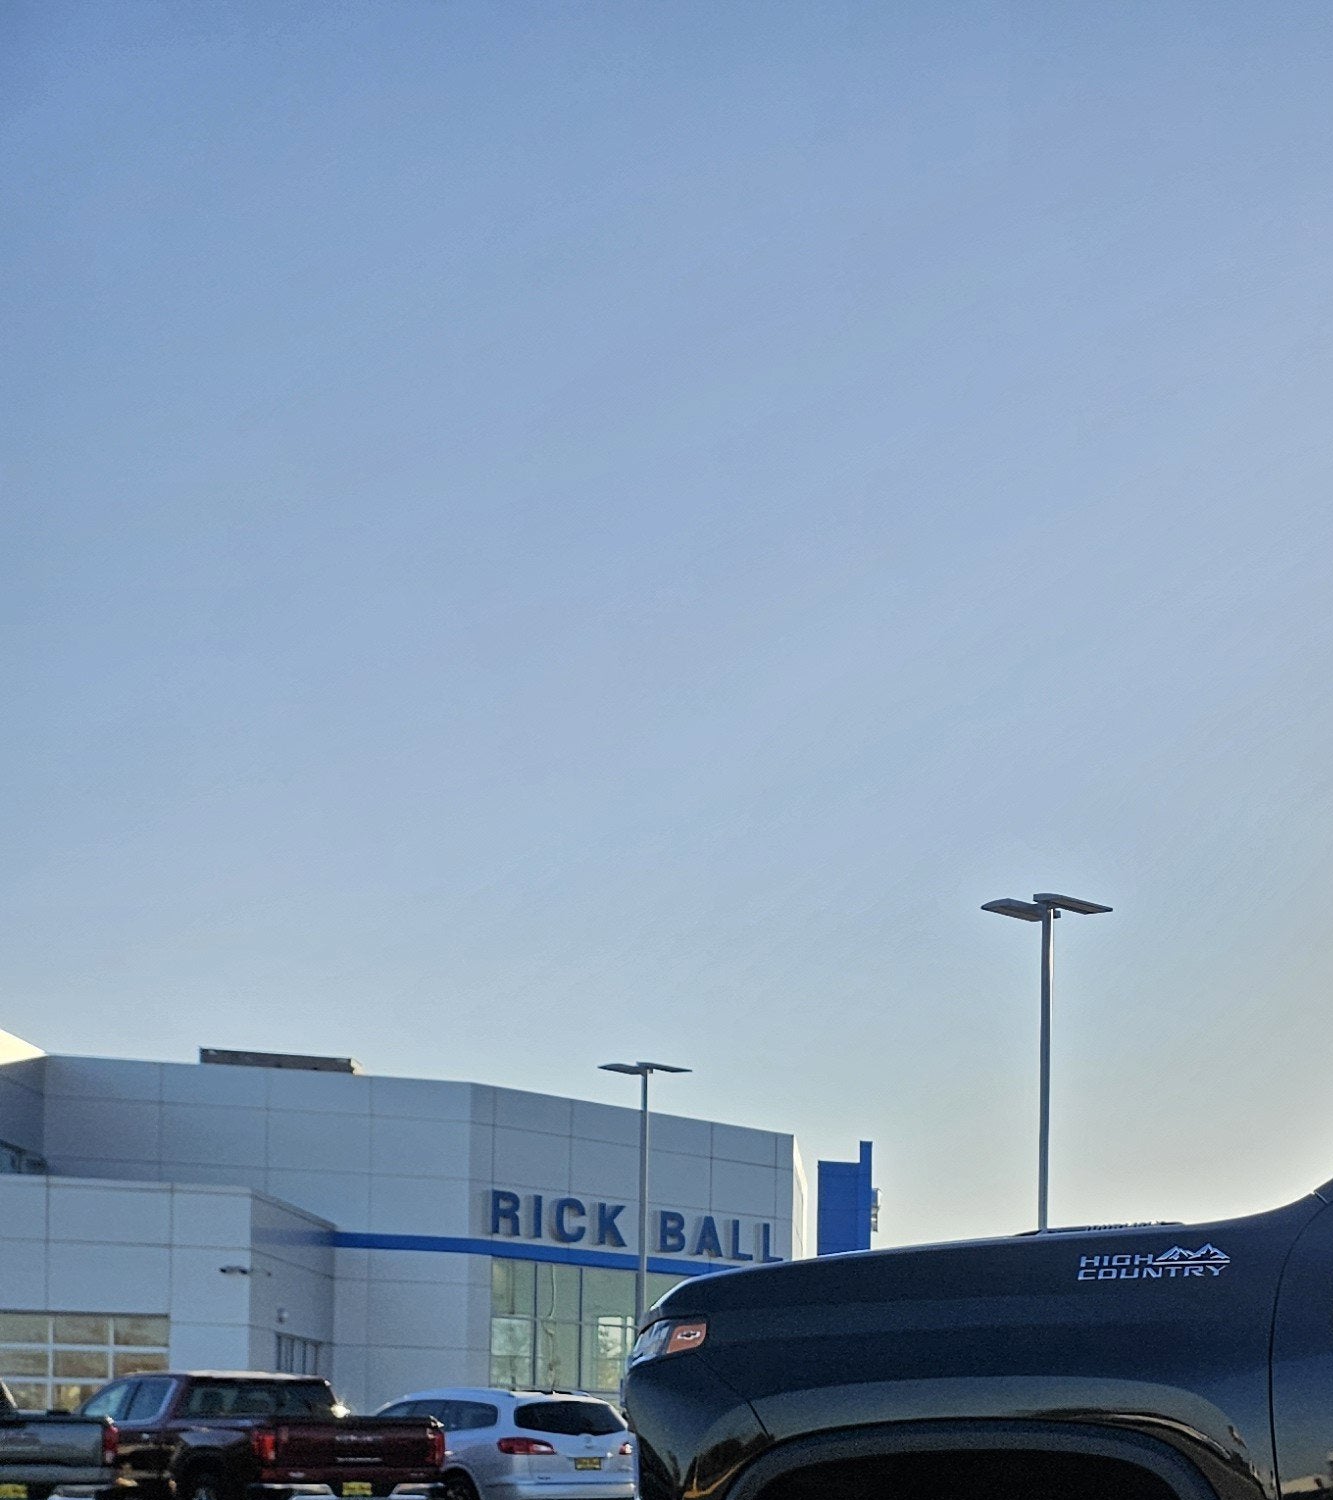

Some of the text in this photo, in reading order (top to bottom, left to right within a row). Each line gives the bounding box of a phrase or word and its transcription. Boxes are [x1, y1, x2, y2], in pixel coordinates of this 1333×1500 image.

[490, 1189, 784, 1264] RICK BALL
[1079, 1254, 1154, 1267] HIGH
[1077, 1265, 1227, 1281] COUNTRY
